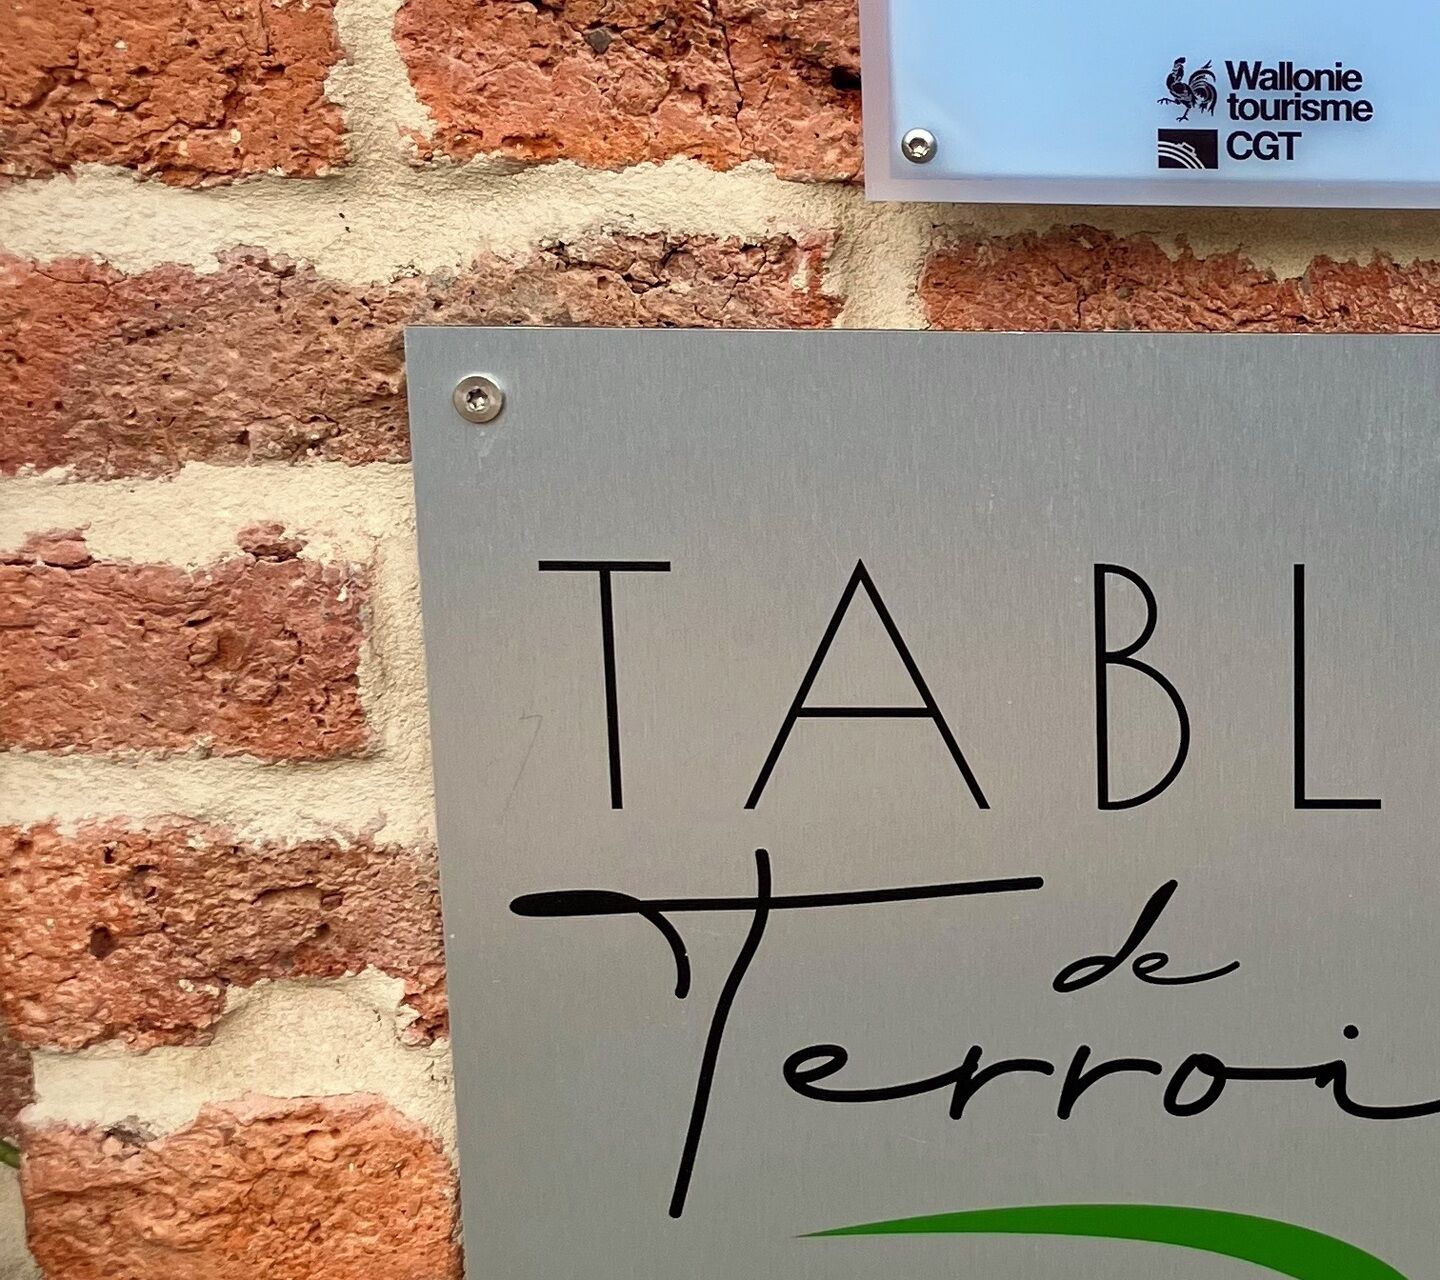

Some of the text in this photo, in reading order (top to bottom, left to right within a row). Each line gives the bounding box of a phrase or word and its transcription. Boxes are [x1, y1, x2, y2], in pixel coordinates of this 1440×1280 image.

[1224, 60, 1363, 93] Wallonie
[1226, 92, 1374, 122] tourisme
[1226, 130, 1303, 161] CGT
[1052, 879, 1241, 994] de
